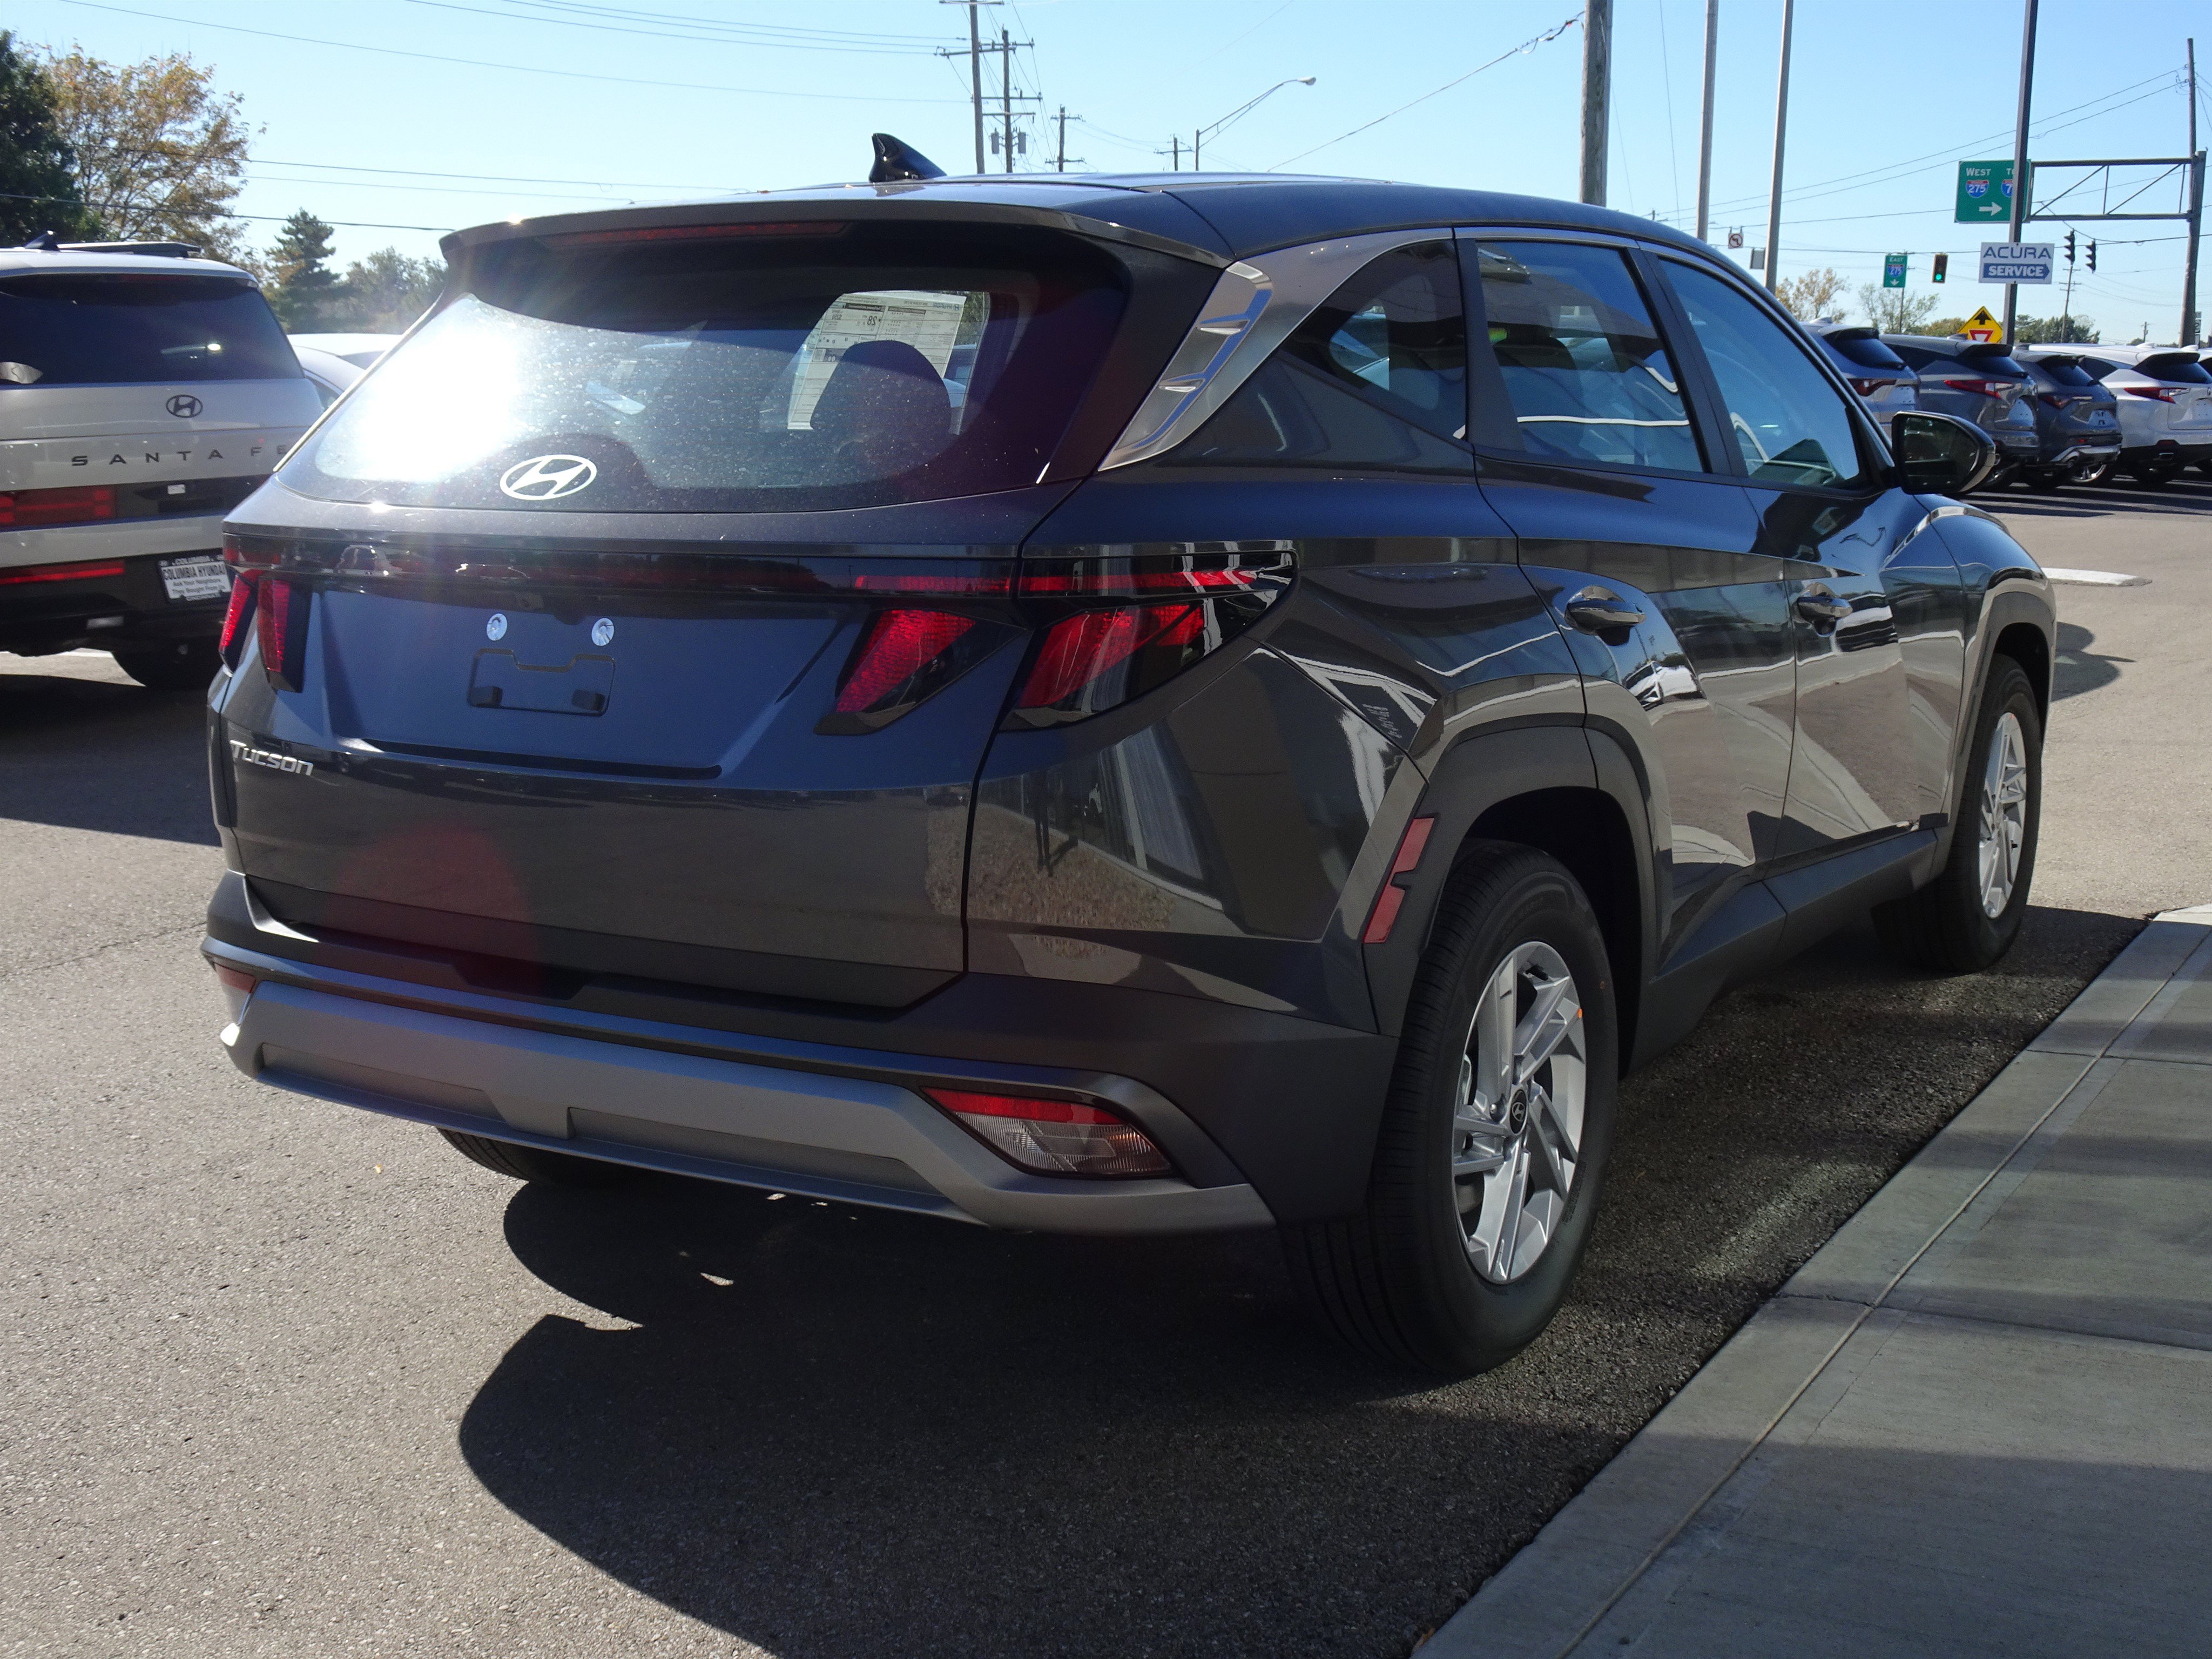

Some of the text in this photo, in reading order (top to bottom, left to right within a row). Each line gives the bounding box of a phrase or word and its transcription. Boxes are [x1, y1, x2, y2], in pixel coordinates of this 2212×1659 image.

[1966, 167, 1991, 176] WEST
[1968, 184, 2013, 194] 275 7
[1983, 246, 2052, 259] ACURA
[1988, 265, 2044, 276] SERVICE
[71, 444, 287, 466] SANTA FE
[164, 563, 226, 580] COLUMBIA HYUNDAI
